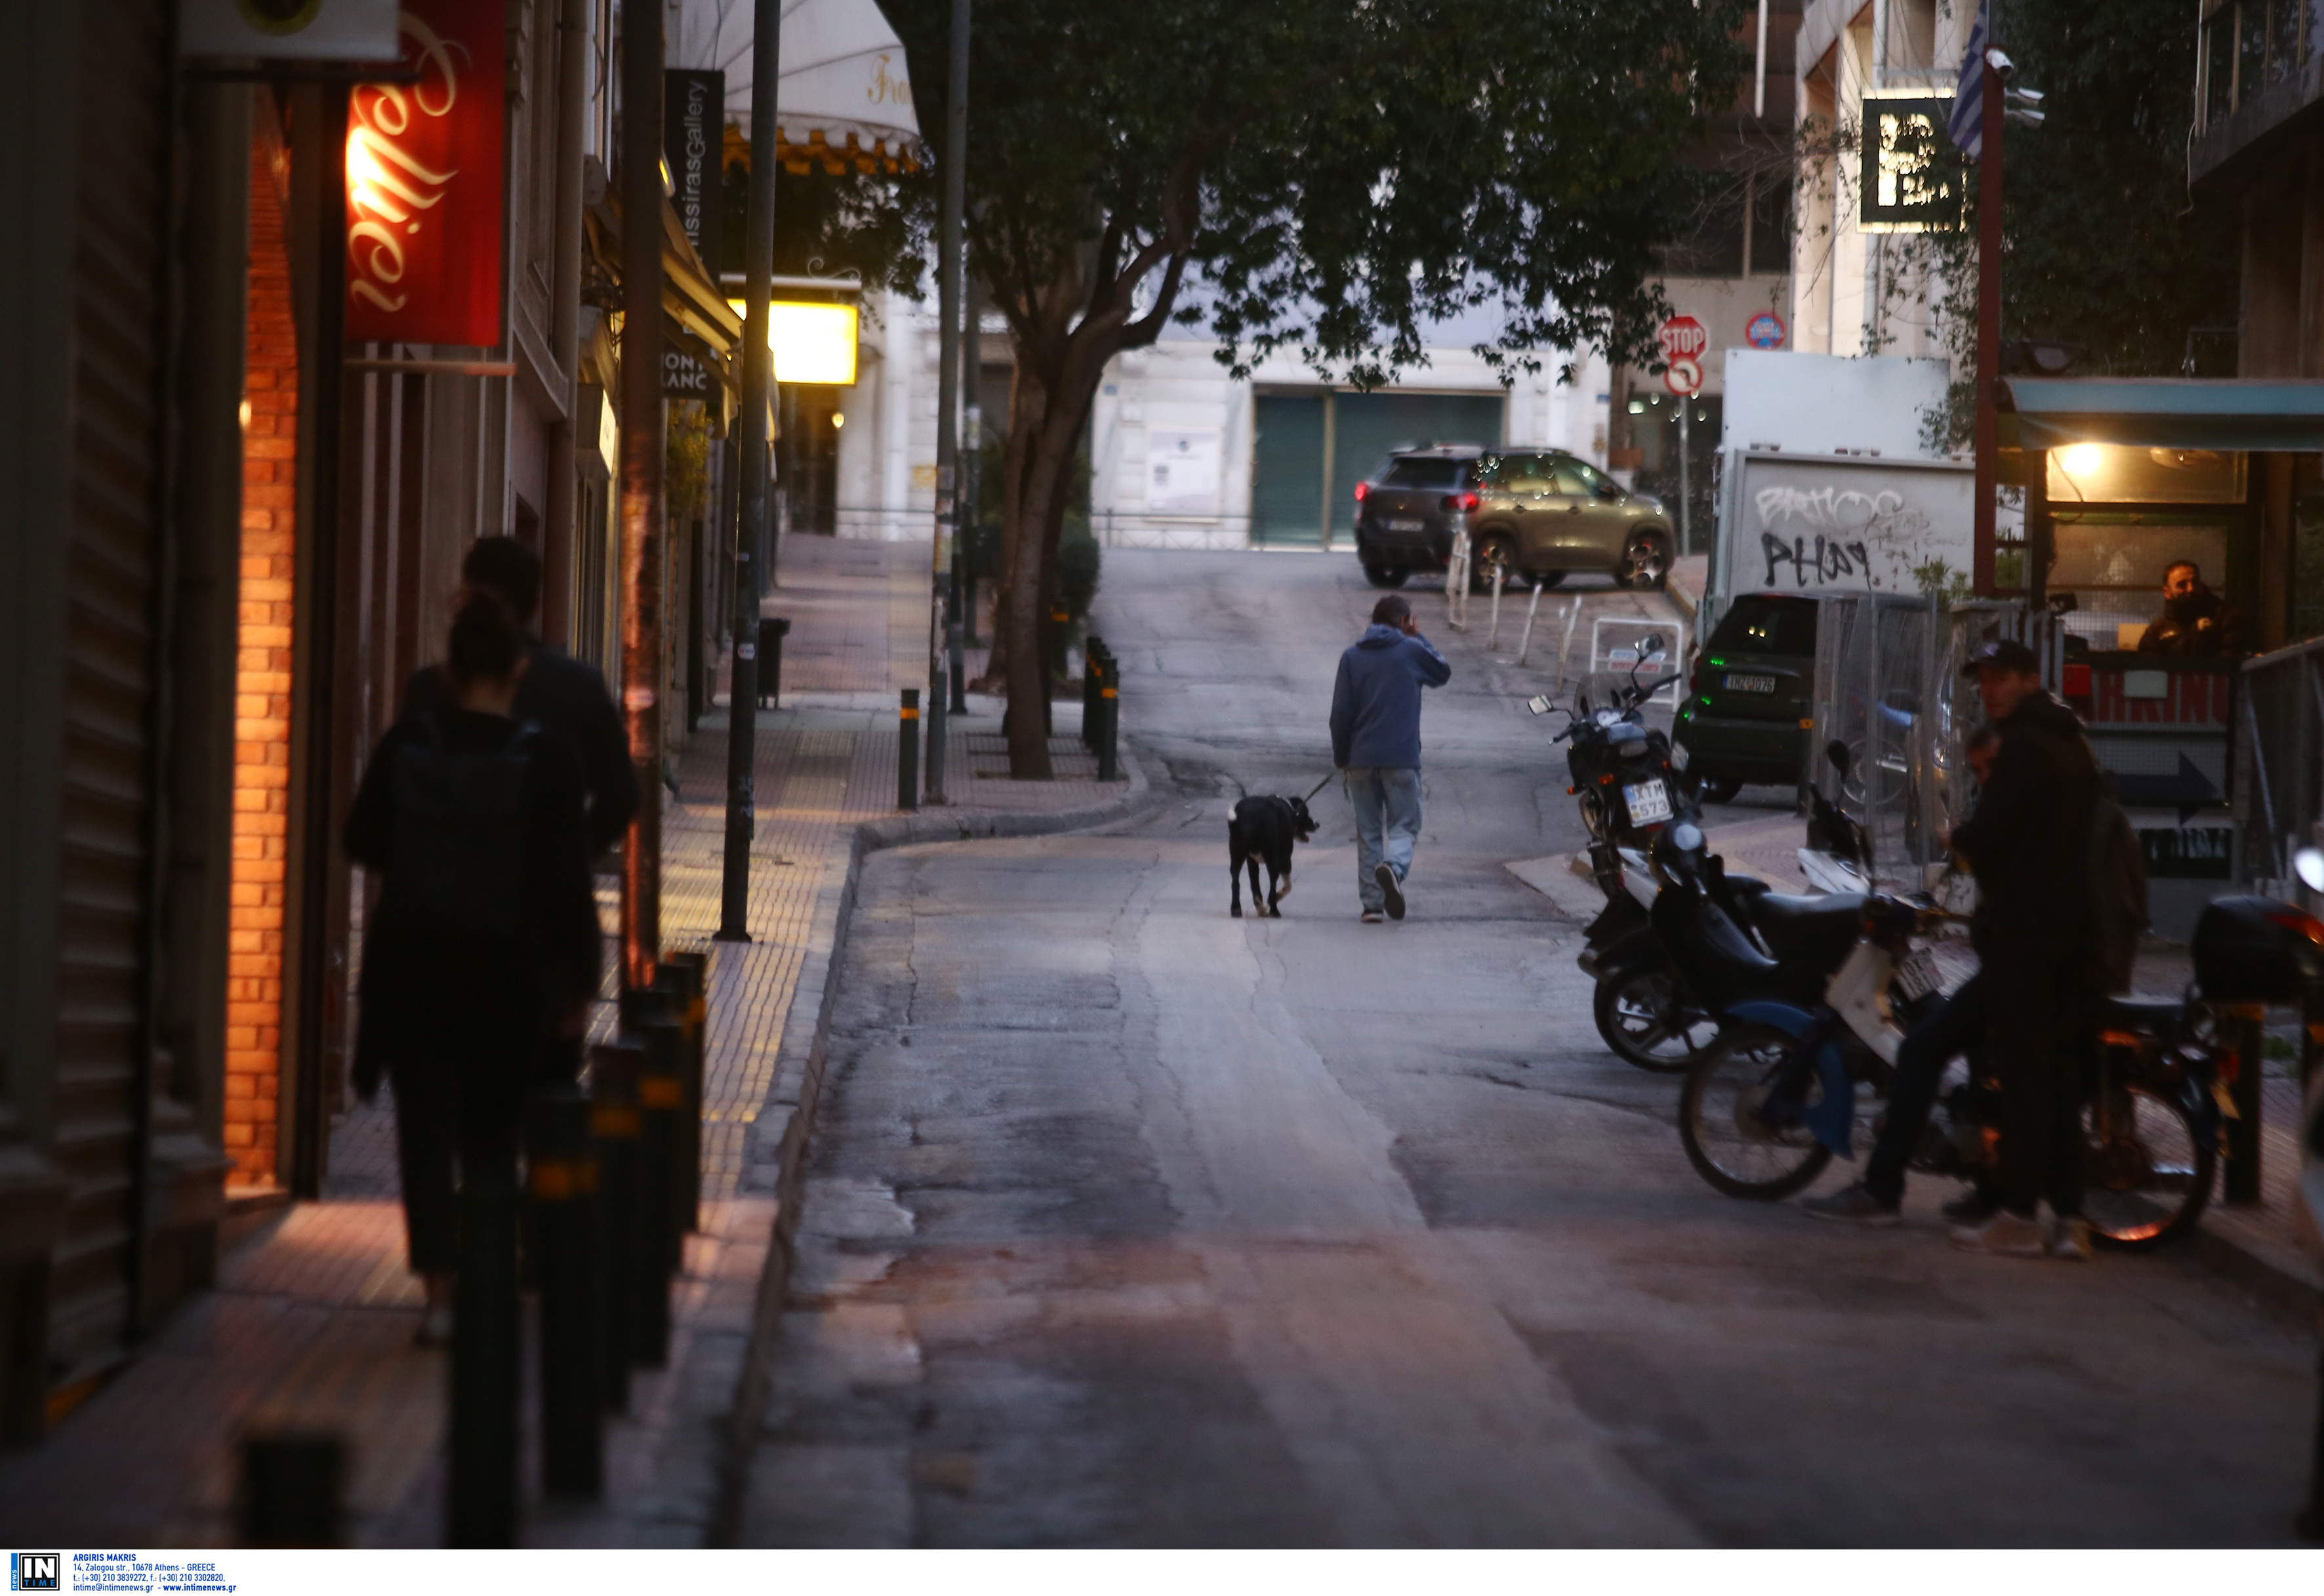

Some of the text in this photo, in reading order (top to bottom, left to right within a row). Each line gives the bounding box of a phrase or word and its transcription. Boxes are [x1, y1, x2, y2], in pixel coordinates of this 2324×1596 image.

[1661, 329, 1703, 354] STOP
[661, 372, 708, 390] ANC
[1639, 800, 1667, 816] 573
